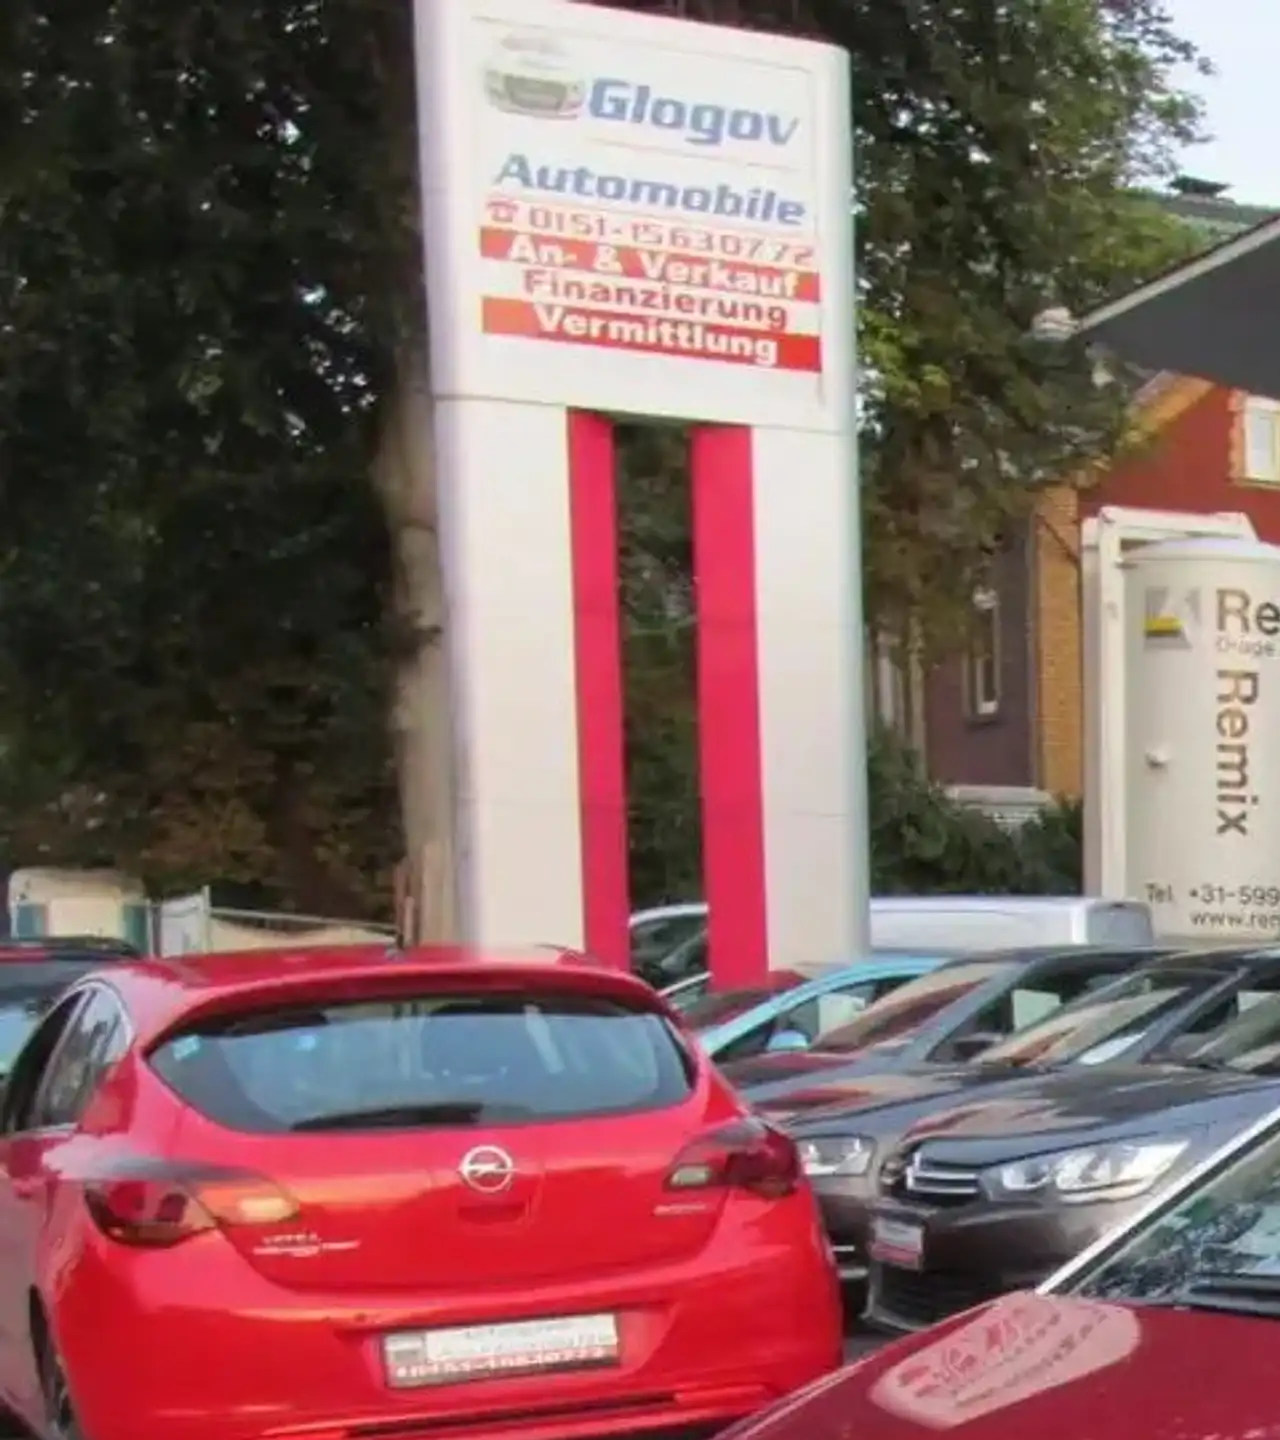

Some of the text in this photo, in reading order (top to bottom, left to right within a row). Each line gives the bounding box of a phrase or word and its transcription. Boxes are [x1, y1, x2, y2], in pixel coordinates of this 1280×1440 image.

[588, 77, 799, 146] Glogov
[494, 153, 806, 225] Automobile
[523, 268, 788, 331] Finanzierung
[593, 243, 623, 274] &
[640, 249, 800, 298] Verkauf
[533, 302, 778, 366] Vermittlung
[1215, 669, 1260, 836] Remix
